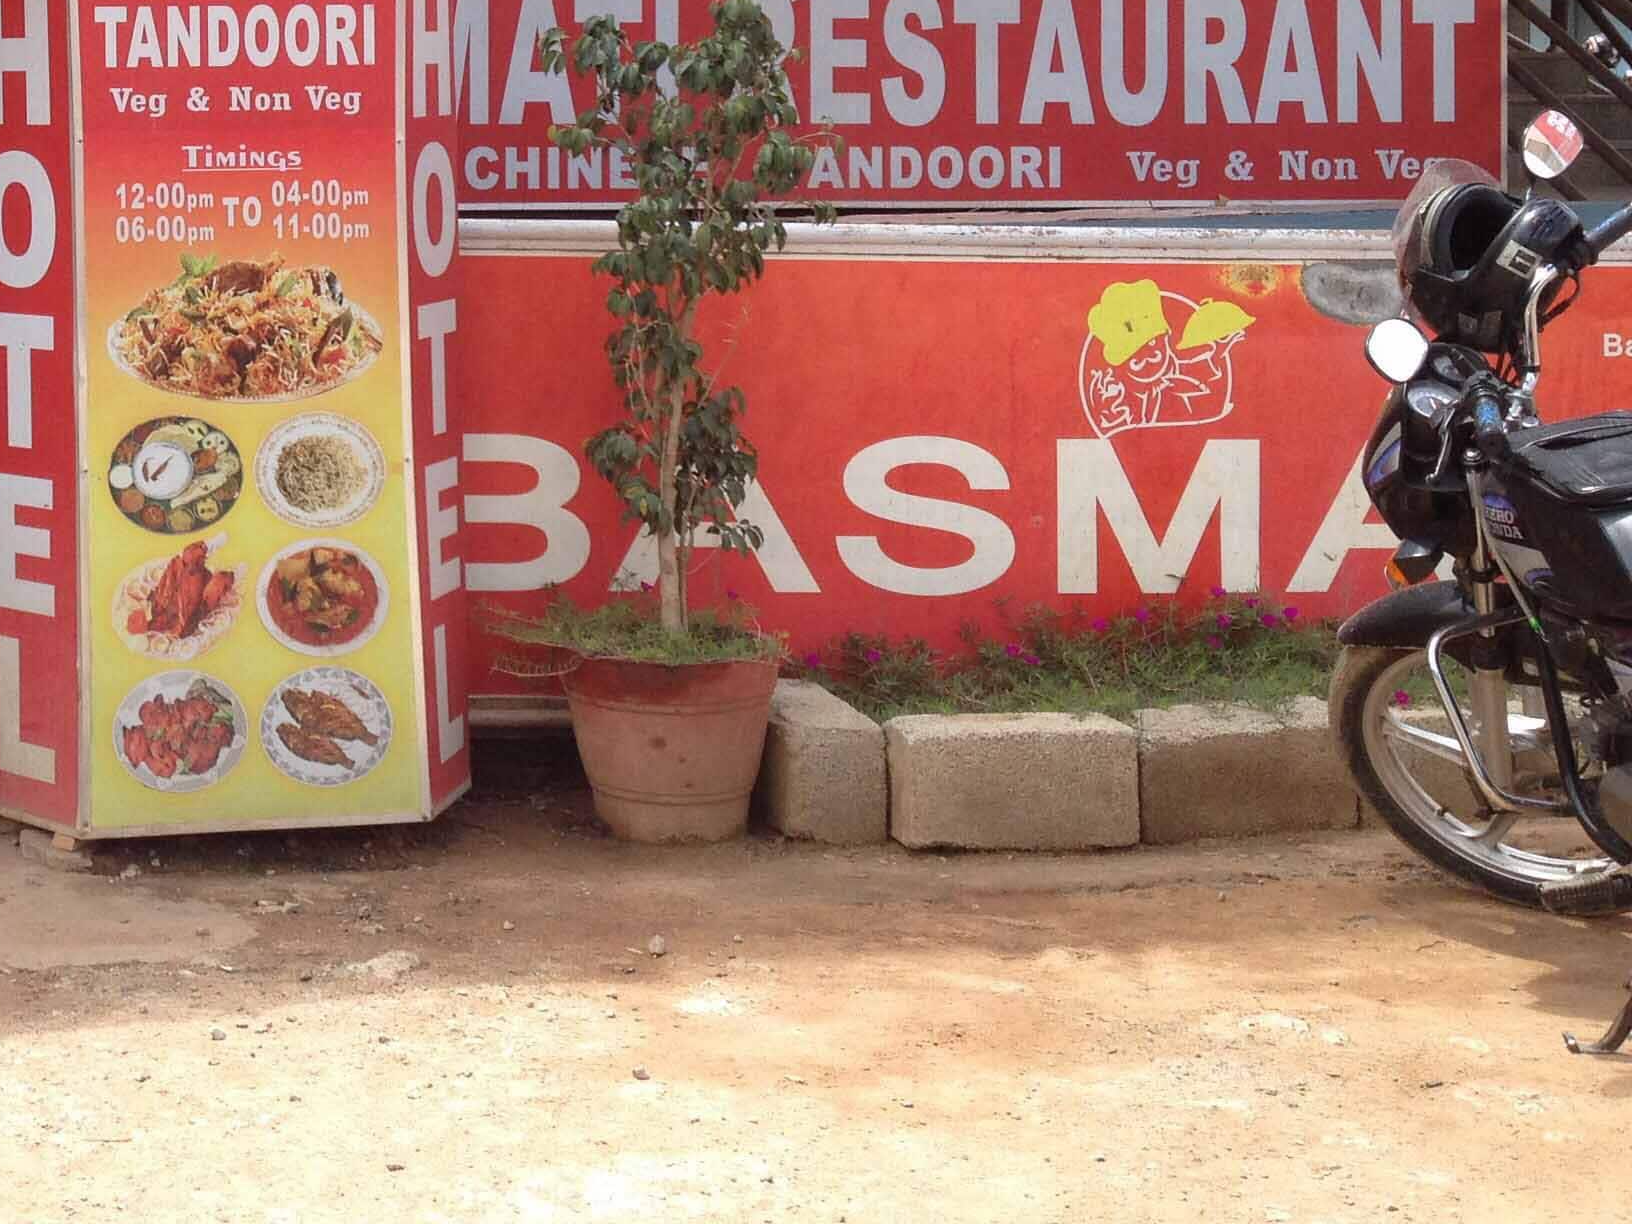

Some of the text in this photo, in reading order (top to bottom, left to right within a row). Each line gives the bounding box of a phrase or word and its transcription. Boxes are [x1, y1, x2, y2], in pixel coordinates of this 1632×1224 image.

[94, 3, 376, 69] TANDOORI
[110, 86, 362, 117] Veg & Non Veg
[465, 145, 710, 190] CHINE
[804, 144, 1061, 190] ANDOORI
[1126, 151, 1200, 188] Veg
[1225, 150, 1255, 182] &
[1279, 150, 1359, 182] Non
[115, 179, 369, 229] 12-00pm TO 04-00pm
[115, 212, 370, 245] 06-00pm 11-00pm
[463, 433, 1456, 598] BASMA
